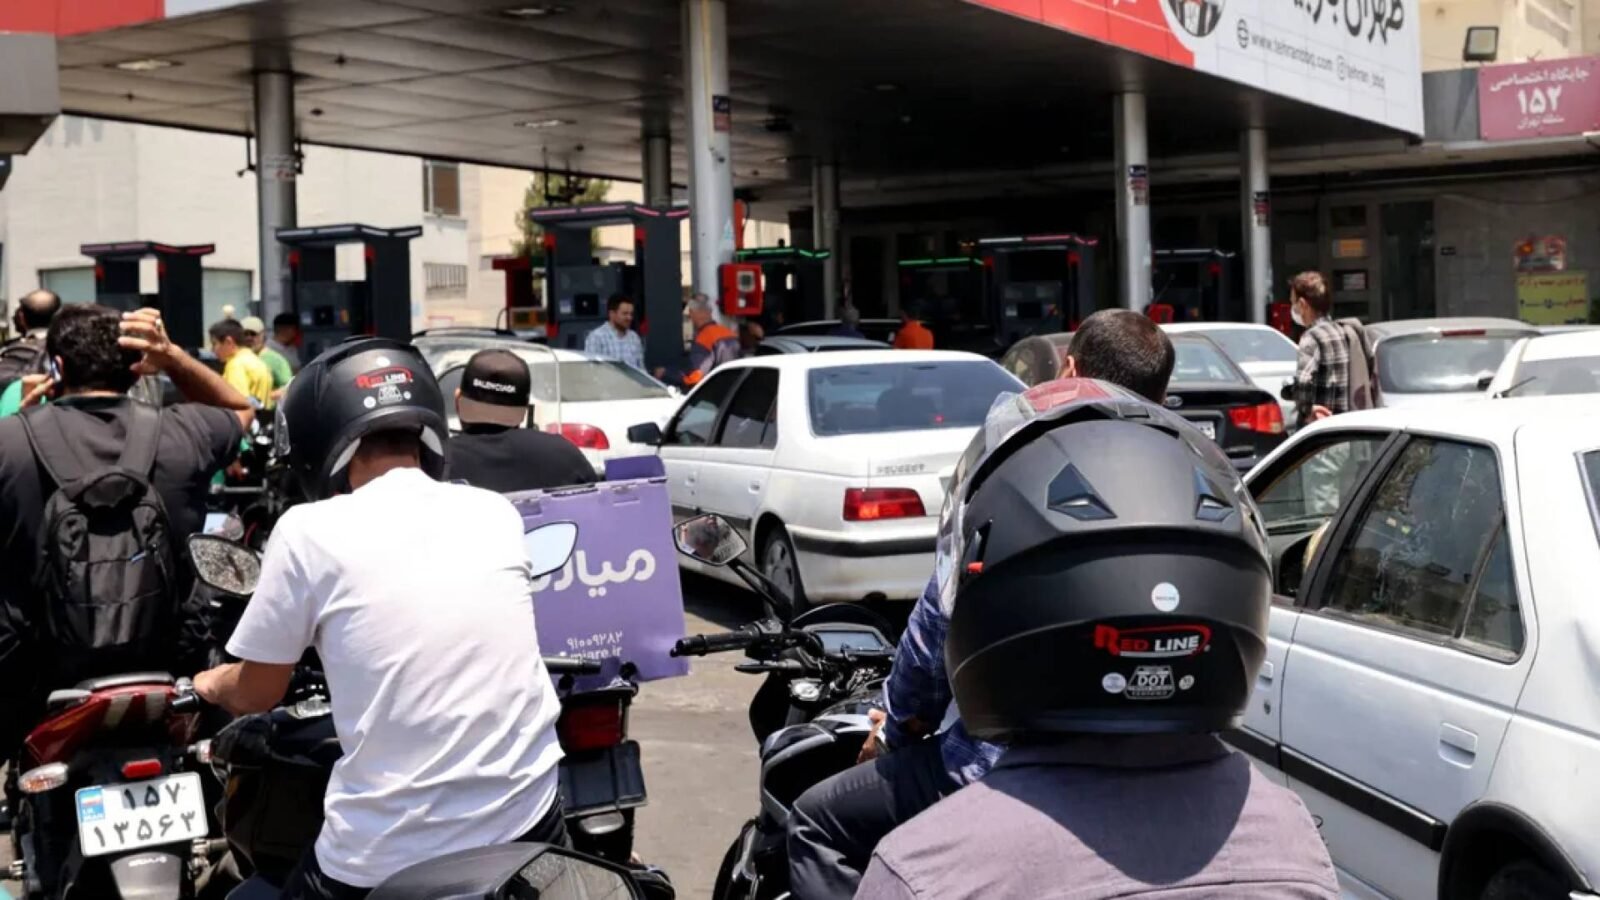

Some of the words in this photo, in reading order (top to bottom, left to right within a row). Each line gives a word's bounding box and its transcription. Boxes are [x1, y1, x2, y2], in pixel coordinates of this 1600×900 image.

[1489, 69, 1549, 92] اختصاصی
[1549, 65, 1590, 84] جایگاه
[1094, 624, 1150, 656] RED
[1154, 635, 1200, 652] LINE
[1137, 674, 1169, 686] DOT
[124, 782, 180, 810] ۱۵۷
[93, 811, 196, 848] ۱۳۵۶۳
